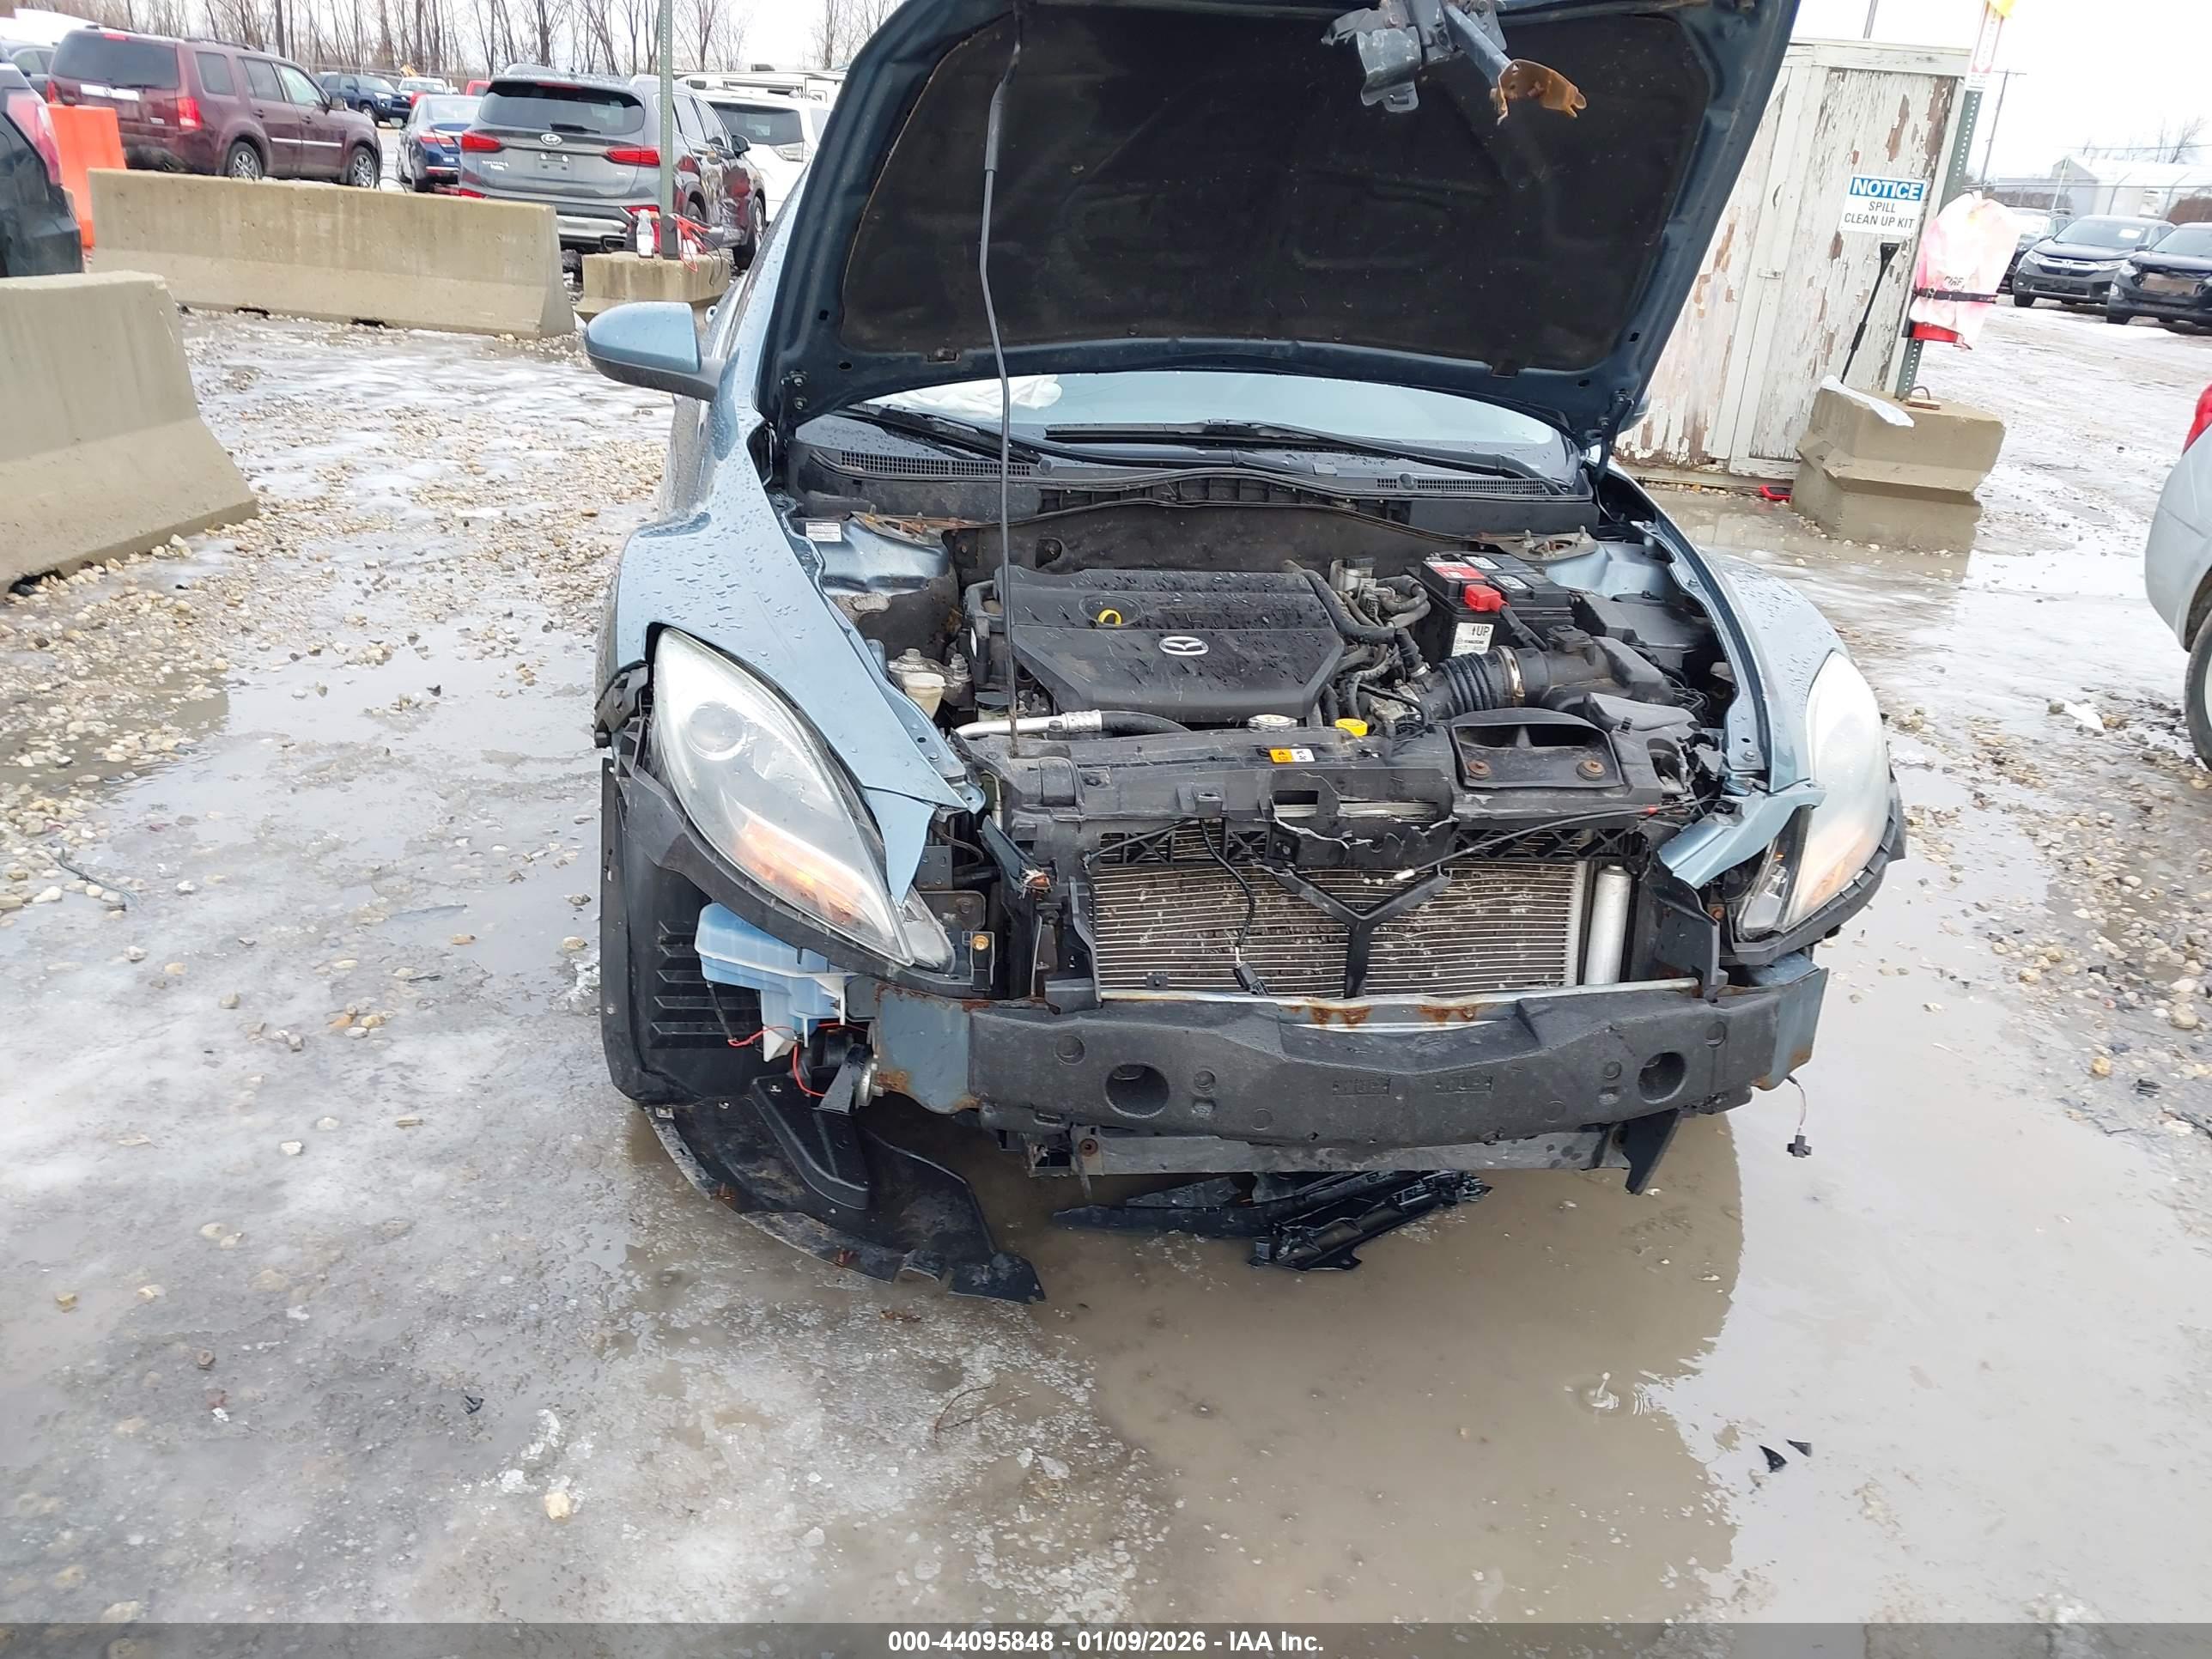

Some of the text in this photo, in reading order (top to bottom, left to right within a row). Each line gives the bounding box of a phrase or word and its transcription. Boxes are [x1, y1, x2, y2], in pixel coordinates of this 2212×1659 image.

[1851, 178, 1922, 200] NOTICE
[1869, 201, 1896, 213] SPILL
[1844, 212, 1915, 228] CLEAN UP KIT
